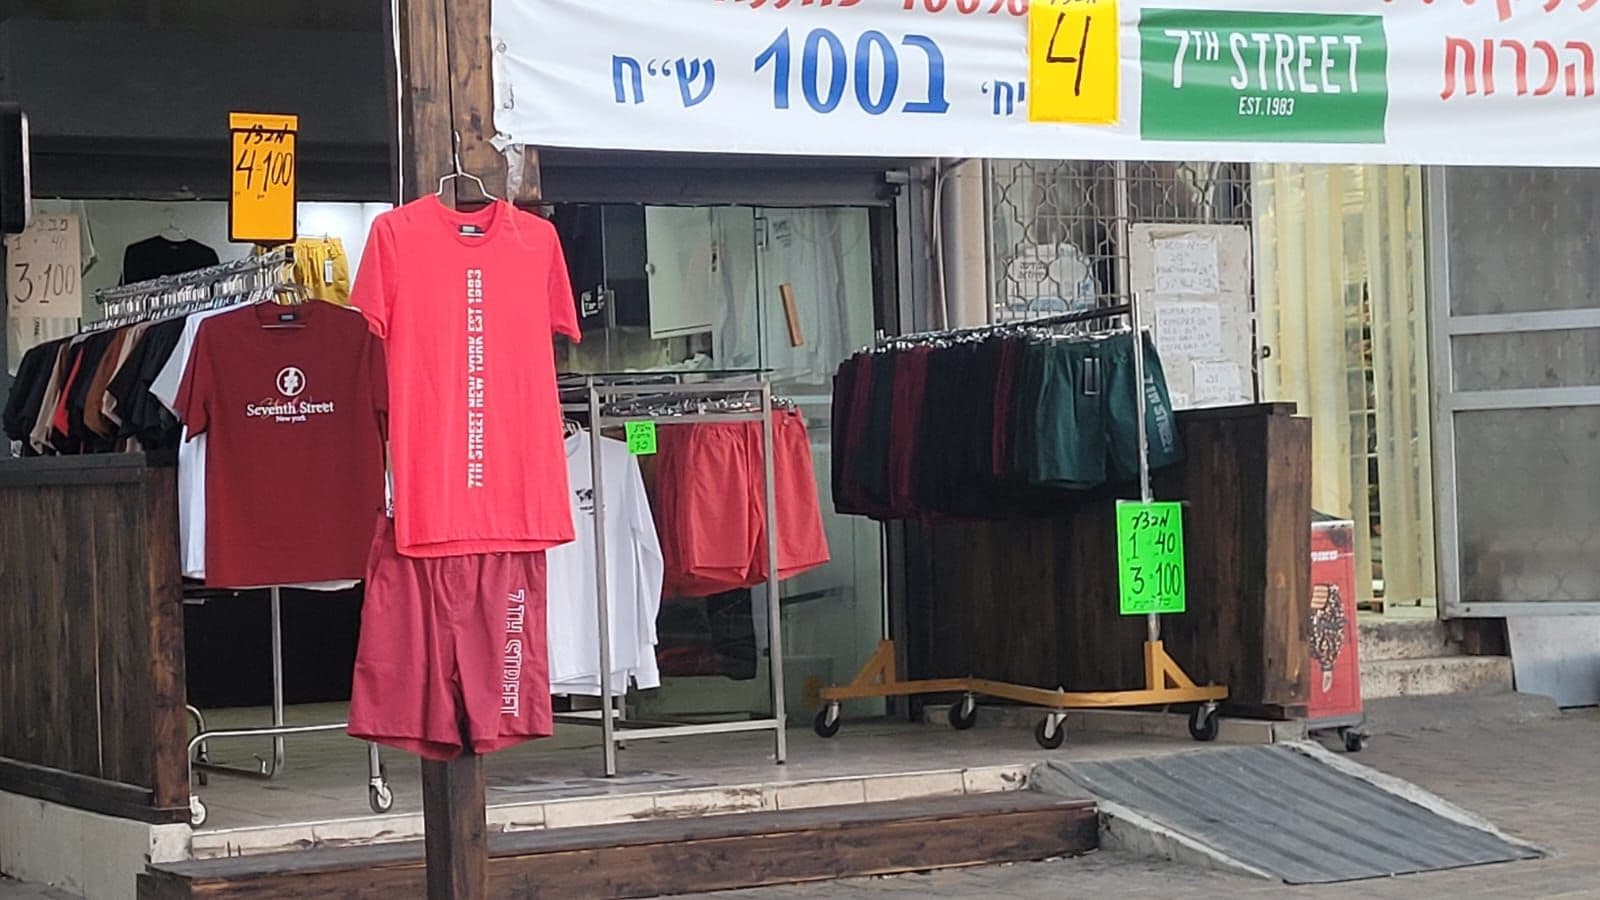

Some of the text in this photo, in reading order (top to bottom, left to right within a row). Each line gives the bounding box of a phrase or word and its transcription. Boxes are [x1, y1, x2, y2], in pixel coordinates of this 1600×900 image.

[753, 27, 950, 116] ב100
[1046, 12, 1091, 96] 4
[1164, 29, 1363, 94] 7TH STREET
[1440, 36, 1595, 100] הכרות
[247, 401, 334, 416] Seventh Street
[466, 268, 485, 489] 7TH STREET NEW YORK EST 1983
[1154, 530, 1176, 555] 40
[1129, 562, 1181, 597] 3 100
[500, 639, 522, 718] STREET
